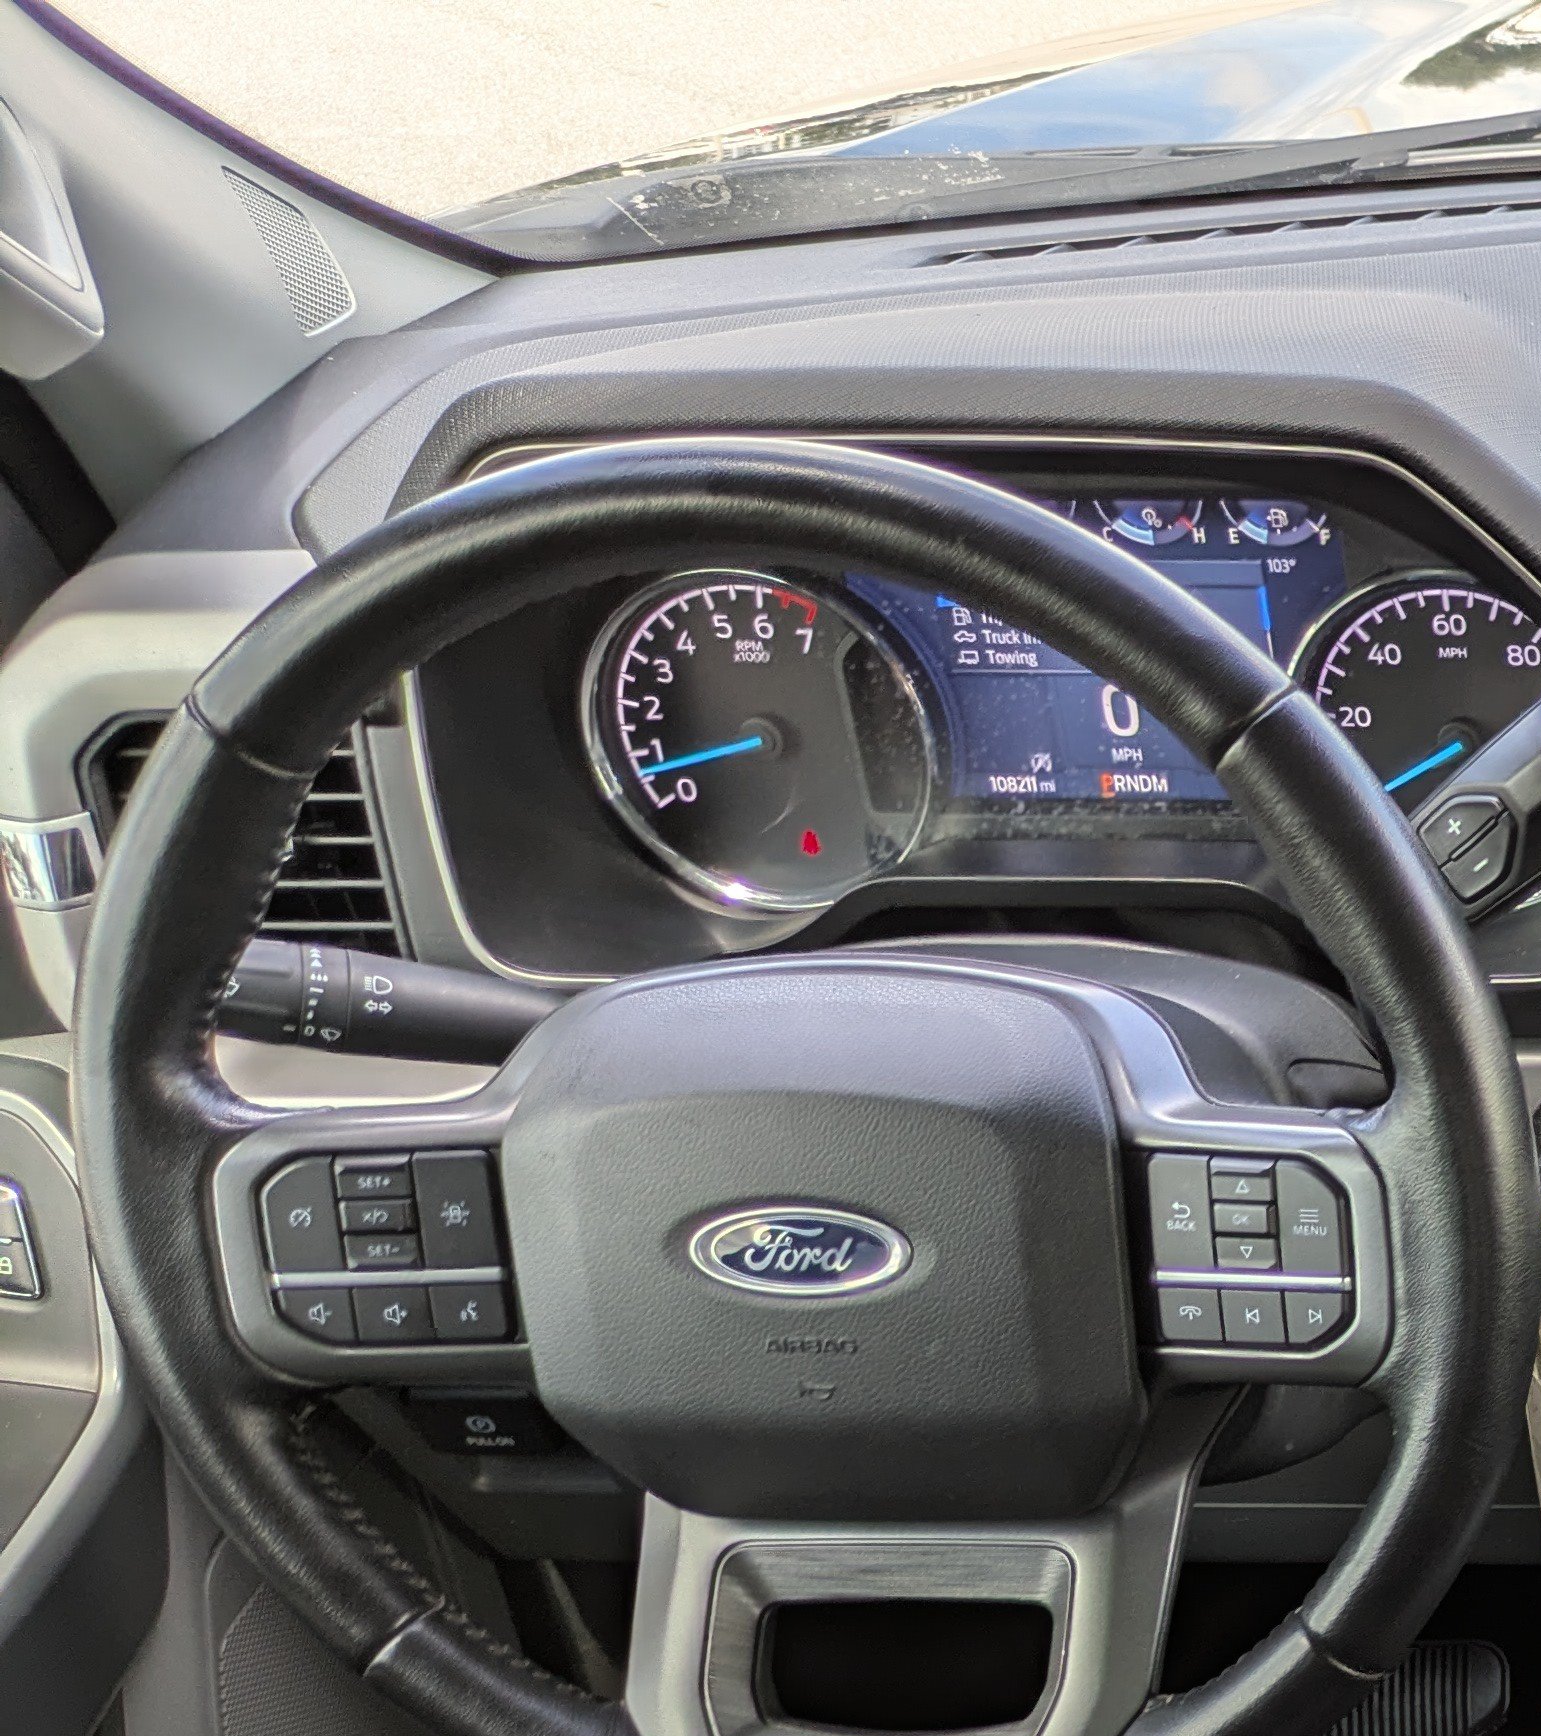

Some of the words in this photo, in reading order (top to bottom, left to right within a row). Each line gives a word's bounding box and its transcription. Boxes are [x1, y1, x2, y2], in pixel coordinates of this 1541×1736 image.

[1193, 526, 1207, 544] H
[1229, 527, 1241, 544] E
[1319, 528, 1332, 546] F
[712, 614, 733, 640] 5
[754, 615, 774, 640] 6
[981, 629, 1021, 645] Truck
[1432, 615, 1467, 637] 60
[676, 629, 696, 656] 4
[735, 640, 764, 651] RPM
[795, 628, 814, 654] 7
[985, 650, 1039, 668] Towing
[1368, 644, 1401, 666] 40
[1438, 646, 1468, 659] MPH
[1507, 645, 1541, 667] 80
[653, 658, 674, 684] 3
[643, 696, 663, 720] 2
[1103, 683, 1140, 737] 0
[1340, 706, 1372, 728] 20
[650, 738, 665, 763] 1
[1112, 747, 1144, 764] MPH
[676, 778, 698, 802] 0
[1039, 777, 1056, 793] mi
[1166, 1219, 1197, 1232] BACK
[1292, 1225, 1328, 1237] MENU
[745, 1224, 853, 1272] Ford
